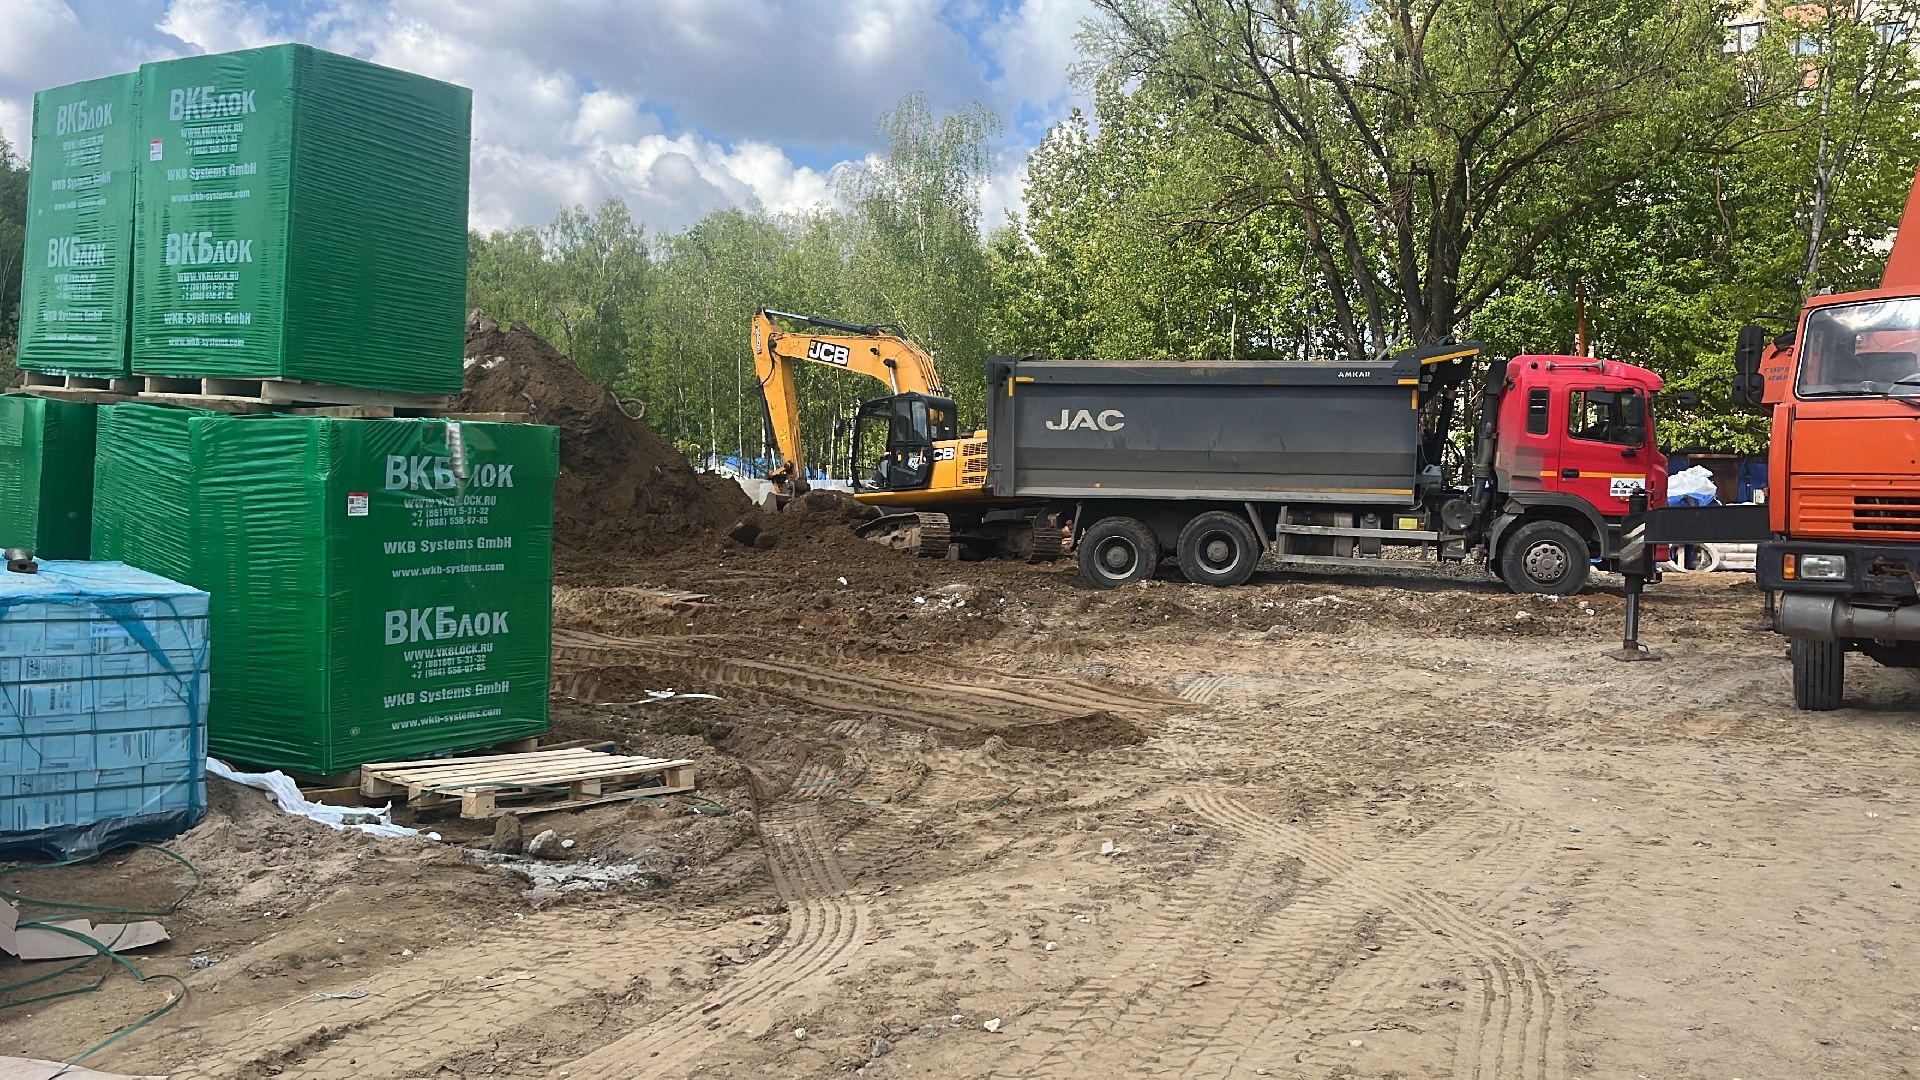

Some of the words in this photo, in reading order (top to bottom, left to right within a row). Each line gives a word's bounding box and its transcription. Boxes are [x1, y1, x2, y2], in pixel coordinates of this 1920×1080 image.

[169, 86, 256, 120] ВКБлок
[57, 100, 113, 136] ВКБлок
[168, 168, 187, 180] WKB
[189, 166, 227, 180] Systems
[229, 163, 256, 176] GmbH
[165, 231, 253, 265] ВКБлок
[164, 313, 184, 325] WKB
[186, 312, 222, 325] Systems
[224, 312, 251, 324] GmbH
[808, 342, 849, 365] JCB
[1045, 409, 1125, 431] JAC
[932, 447, 955, 461] CB
[411, 509, 423, 518] +7
[459, 506, 489, 515] 5-31-32
[411, 519, 423, 527] +7
[384, 540, 416, 554] WKB
[420, 538, 474, 553] Systems
[477, 536, 512, 549] GmbH
[391, 563, 504, 578] www.wkb-systems.com
[385, 605, 509, 645] ВКБлок
[403, 642, 493, 662] WWW.VKBLOCK.RU
[411, 661, 423, 670] +7
[457, 654, 487, 664] 5-31-32
[411, 671, 423, 679] +7
[383, 692, 415, 709] WKB
[419, 687, 472, 703] Systems
[475, 681, 510, 696] GmbH
[391, 708, 501, 730] www.wkb-systems.com
